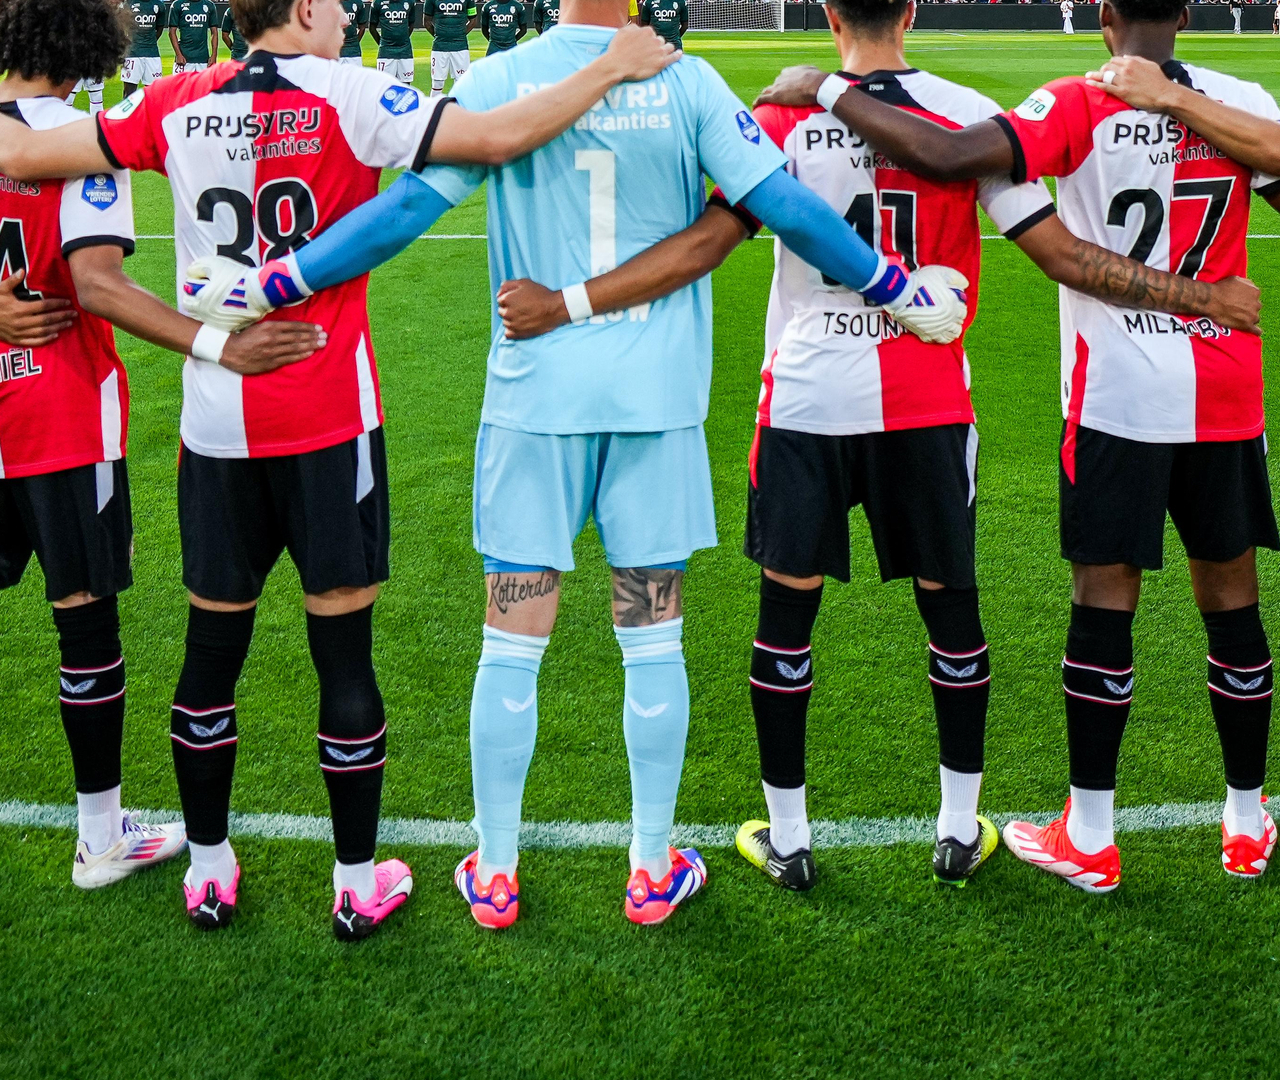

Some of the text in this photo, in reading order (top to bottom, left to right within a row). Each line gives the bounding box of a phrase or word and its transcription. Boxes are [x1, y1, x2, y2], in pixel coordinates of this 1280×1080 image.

[439, 2, 462, 13] apm
[547, 9, 560, 18] ap
[135, 15, 157, 25] apm
[185, 13, 207, 25] apm
[384, 10, 407, 21] apm
[492, 13, 513, 25] apm
[654, 9, 678, 21] apm
[575, 110, 671, 132] akanties
[1148, 146, 1230, 167] vakantie
[574, 150, 616, 277] 1
[1107, 176, 1237, 280] 27
[823, 312, 904, 339] TSOUN
